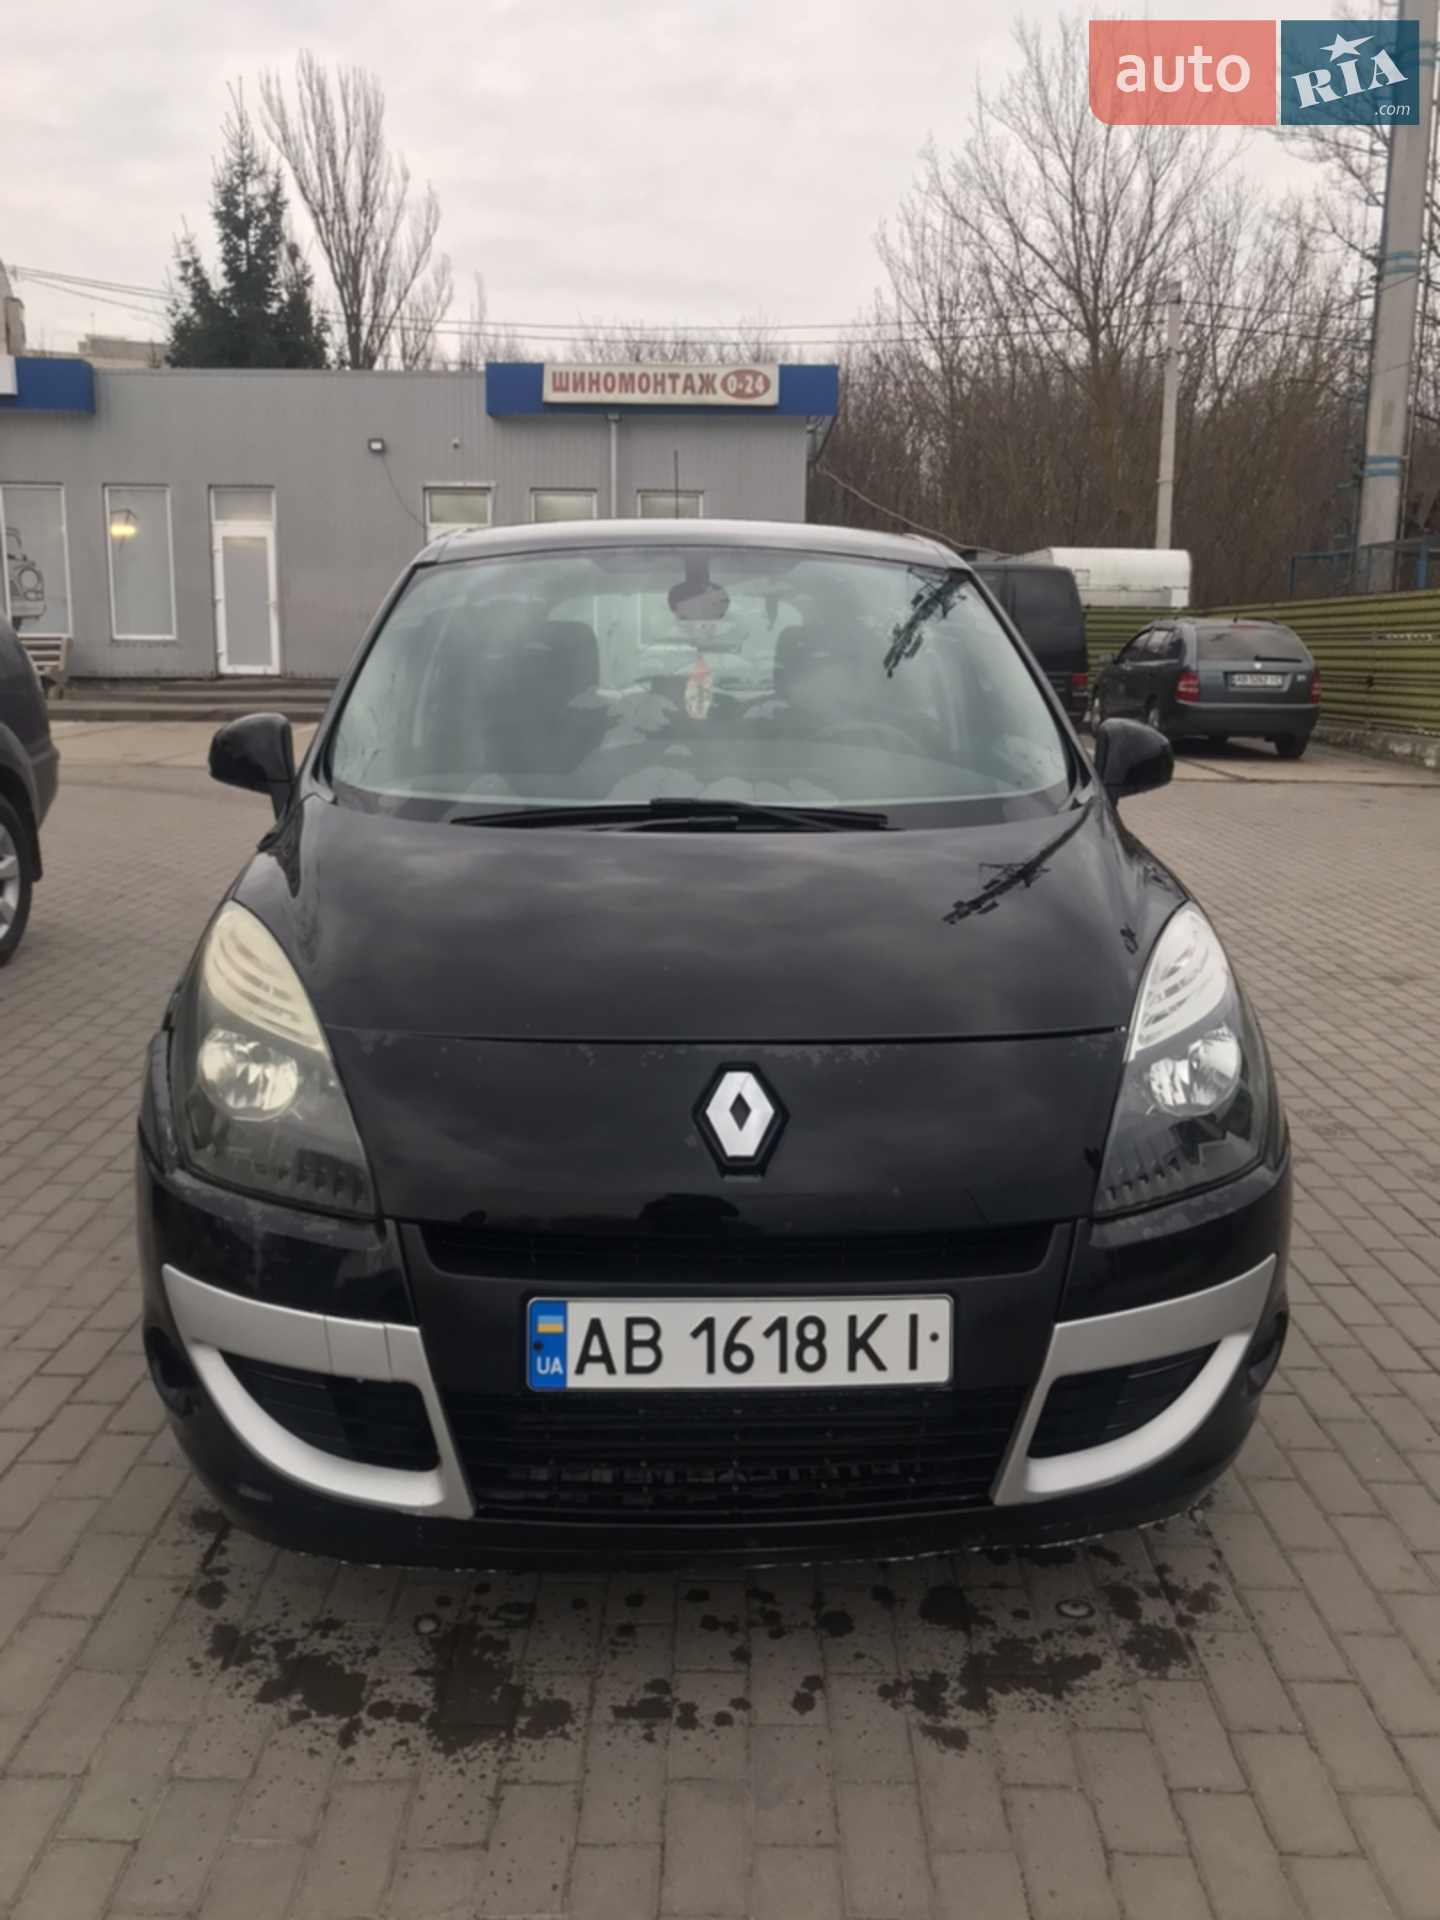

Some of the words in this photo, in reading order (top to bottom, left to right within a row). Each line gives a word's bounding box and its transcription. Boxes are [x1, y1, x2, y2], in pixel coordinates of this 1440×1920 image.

[551, 370, 718, 396] ШИНОМОНТАЖ
[726, 374, 766, 395] 0-24
[574, 1316, 663, 1376] AB
[690, 1314, 827, 1375] 1618
[847, 1313, 919, 1372] KI
[536, 1356, 564, 1376] UA
